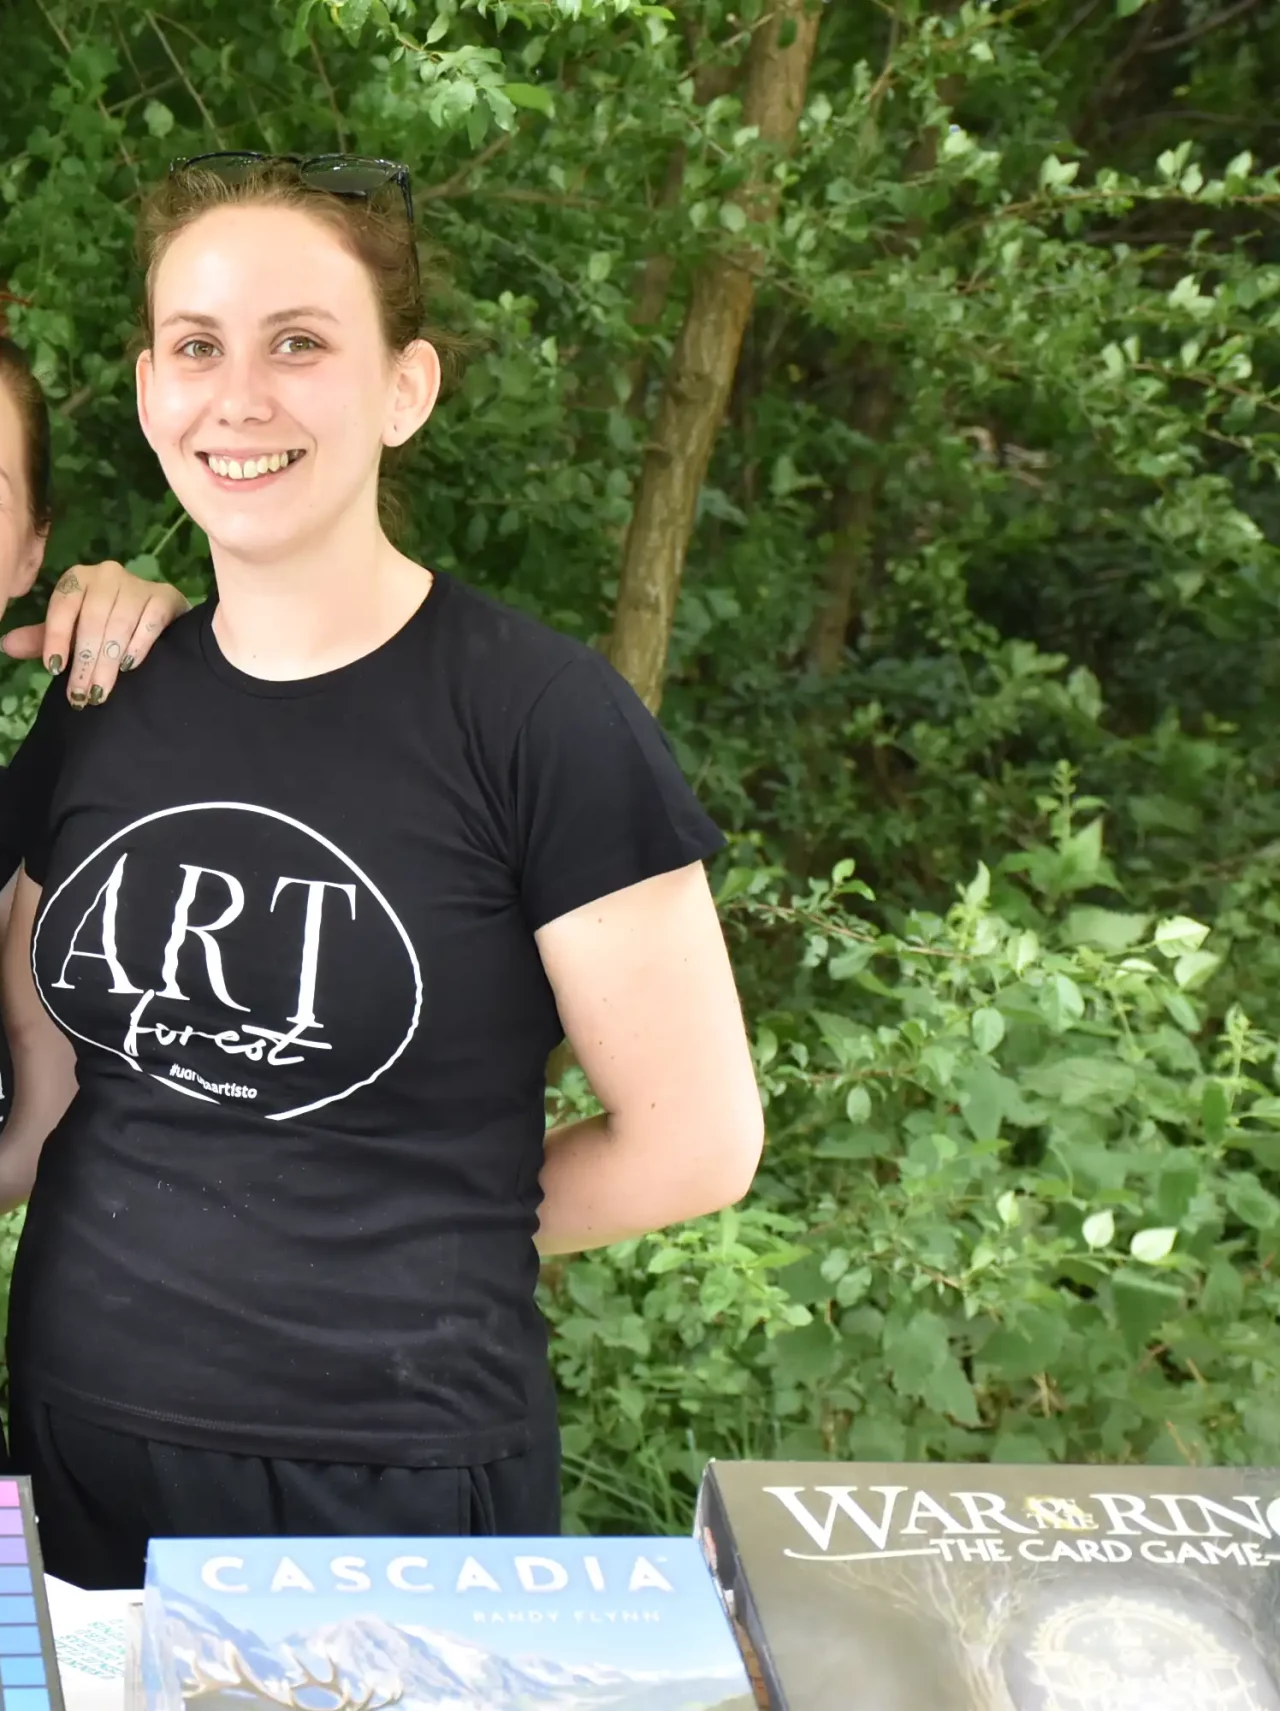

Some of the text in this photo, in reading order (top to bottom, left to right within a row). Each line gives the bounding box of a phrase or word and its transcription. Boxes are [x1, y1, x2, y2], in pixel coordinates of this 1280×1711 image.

[52, 853, 356, 1028] ART
[124, 989, 332, 1066] forest
[763, 1486, 1038, 1550] WAR
[201, 1555, 674, 1593] CASCADIA
[932, 1538, 1271, 1567] THE CARD GAME
